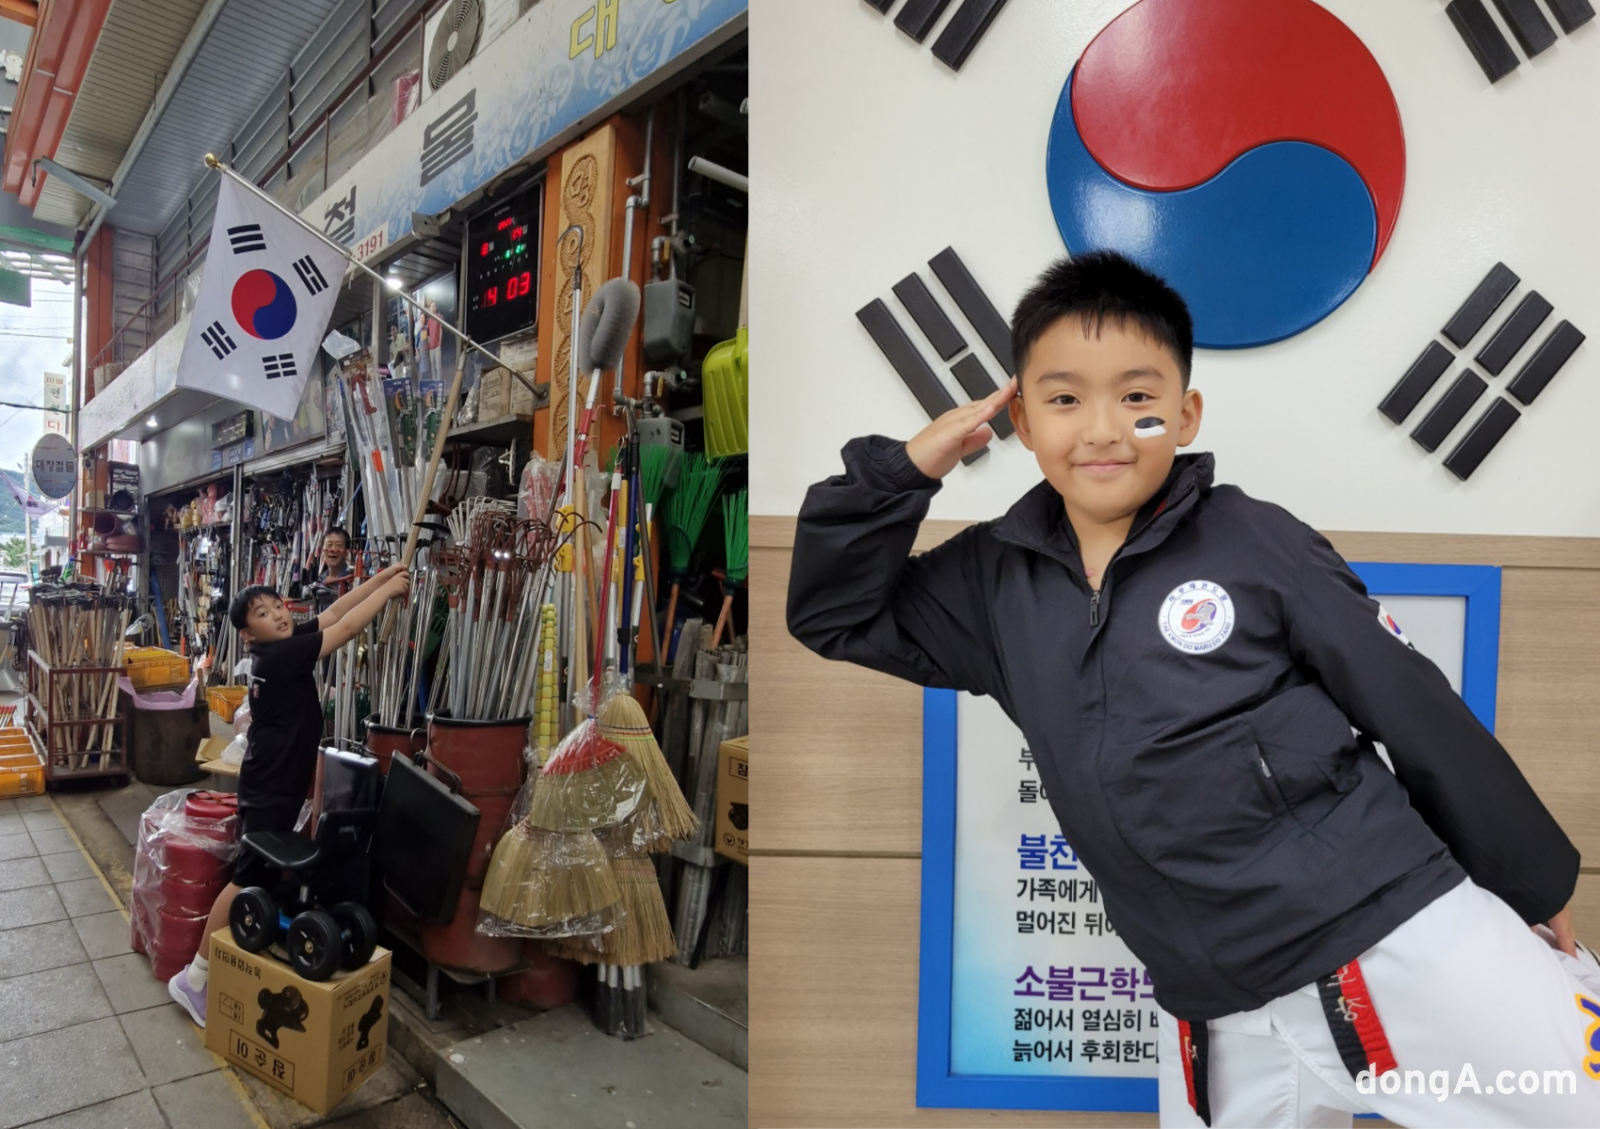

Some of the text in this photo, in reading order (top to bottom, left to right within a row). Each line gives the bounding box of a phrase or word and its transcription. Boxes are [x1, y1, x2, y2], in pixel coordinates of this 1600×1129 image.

[36, 460, 74, 473] 대장철물
[1167, 633, 1183, 646] KWON
[1194, 643, 1212, 651] MARU
[1221, 622, 1232, 638] JANG
[1016, 877, 1098, 904] 가족에게
[1016, 910, 1076, 935] 멀어진
[1014, 1007, 1073, 1031] 젊어서
[1082, 1009, 1141, 1032] 열심히
[1013, 1039, 1072, 1062] 늙어서
